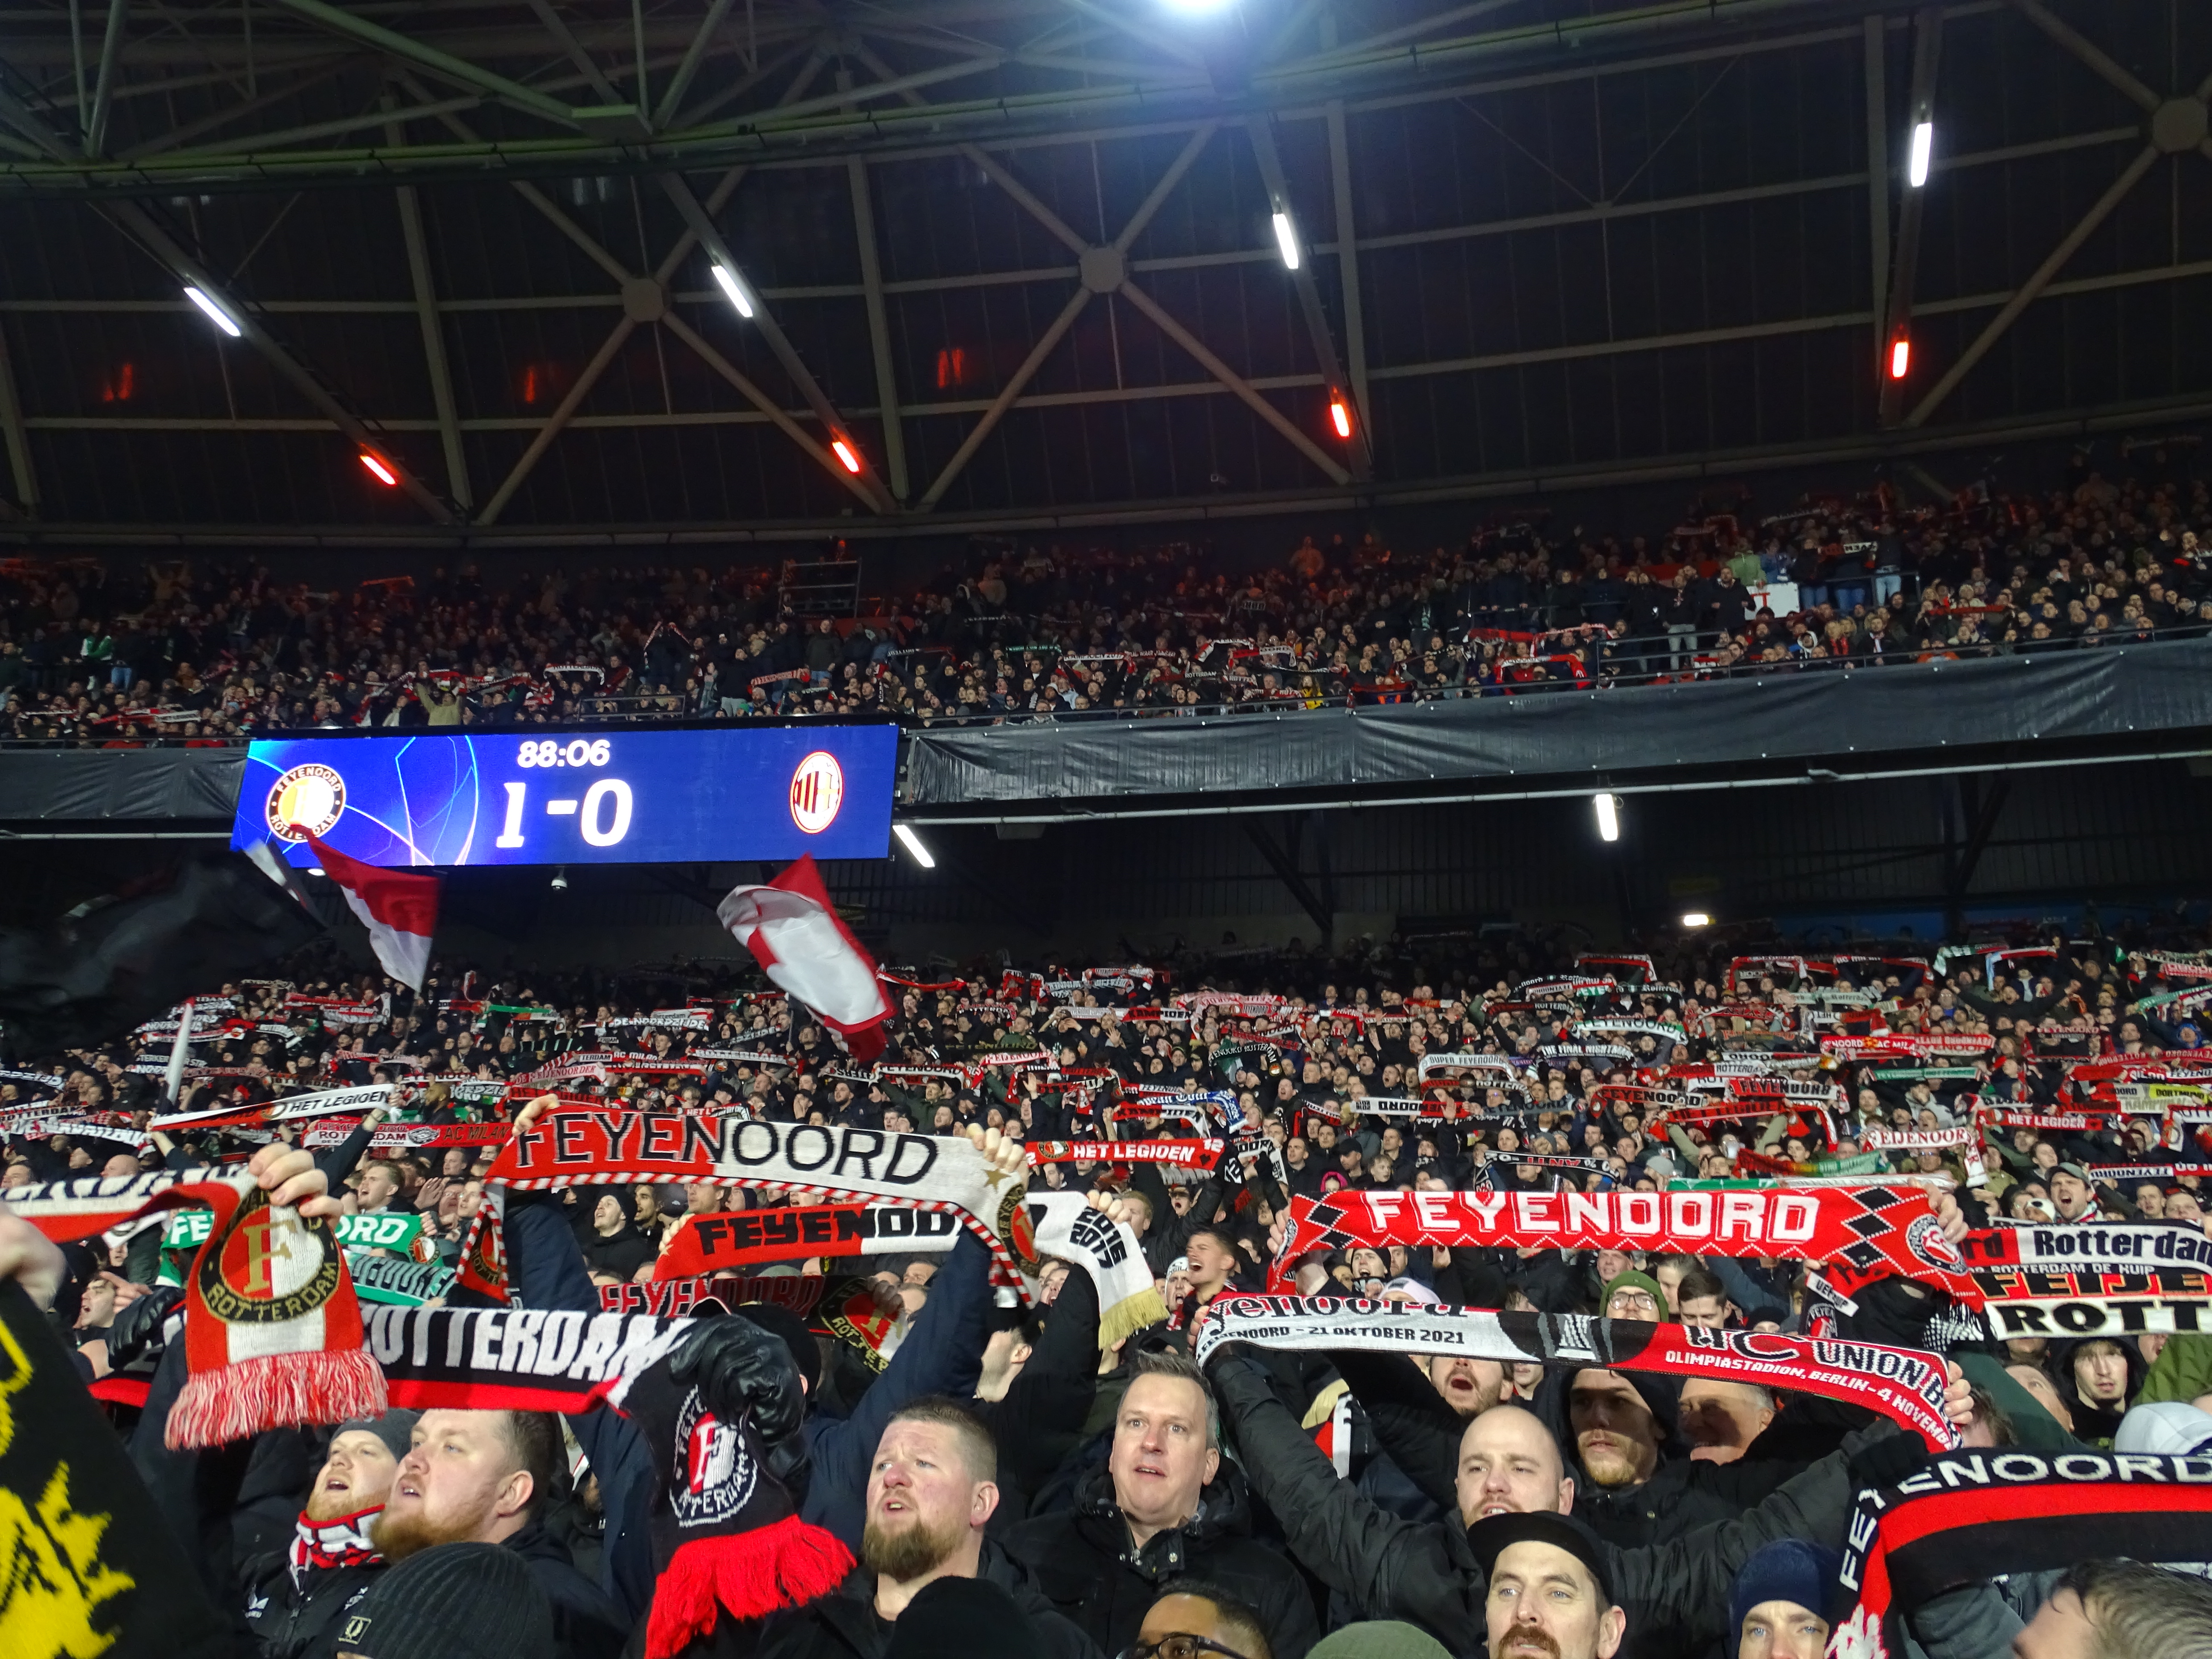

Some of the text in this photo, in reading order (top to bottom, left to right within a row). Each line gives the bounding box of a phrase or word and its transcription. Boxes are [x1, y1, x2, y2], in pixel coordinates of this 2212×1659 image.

[518, 740, 610, 768] 88:06
[276, 767, 341, 792] FEYENOORD
[270, 812, 337, 841] ROTTEDAM
[1542, 1045, 1557, 1054] THE
[1558, 1045, 1582, 1054] FINAL
[1831, 1040, 1863, 1048] NOORD
[1893, 1042, 1915, 1051] MILA
[1430, 1054, 1455, 1064] SUPER
[290, 1091, 391, 1113] HET LEGIOEN
[1602, 1089, 1701, 1106] FEYENOOD
[443, 1125, 511, 1141] AC MILAN
[2008, 1113, 2086, 1129] HET LEGIOEN
[515, 1111, 939, 1185] FEYENOORD
[1073, 1144, 1110, 1158] HET
[1114, 1144, 1196, 1162] LEGIOEN
[1203, 1138, 1225, 1153] 12
[1360, 1190, 1821, 1244] FEYENOORD
[695, 1208, 952, 1256] FEYENOO
[1077, 1206, 1128, 1266] 2016
[1069, 1223, 1115, 1269] 2017
[1990, 1263, 2155, 1275] ROTTERDAM DE KUIP
[207, 1260, 340, 1321] ROTTERDAM
[832, 1316, 889, 1371] ROTTER
[1309, 1327, 1329, 1335] 21
[1333, 1327, 1416, 1342] OKTOBER
[1420, 1329, 1465, 1345] 2021
[1812, 1341, 1930, 1391] UNION
[1808, 1370, 1869, 1393] BERLIN
[1877, 1387, 1893, 1403] 4
